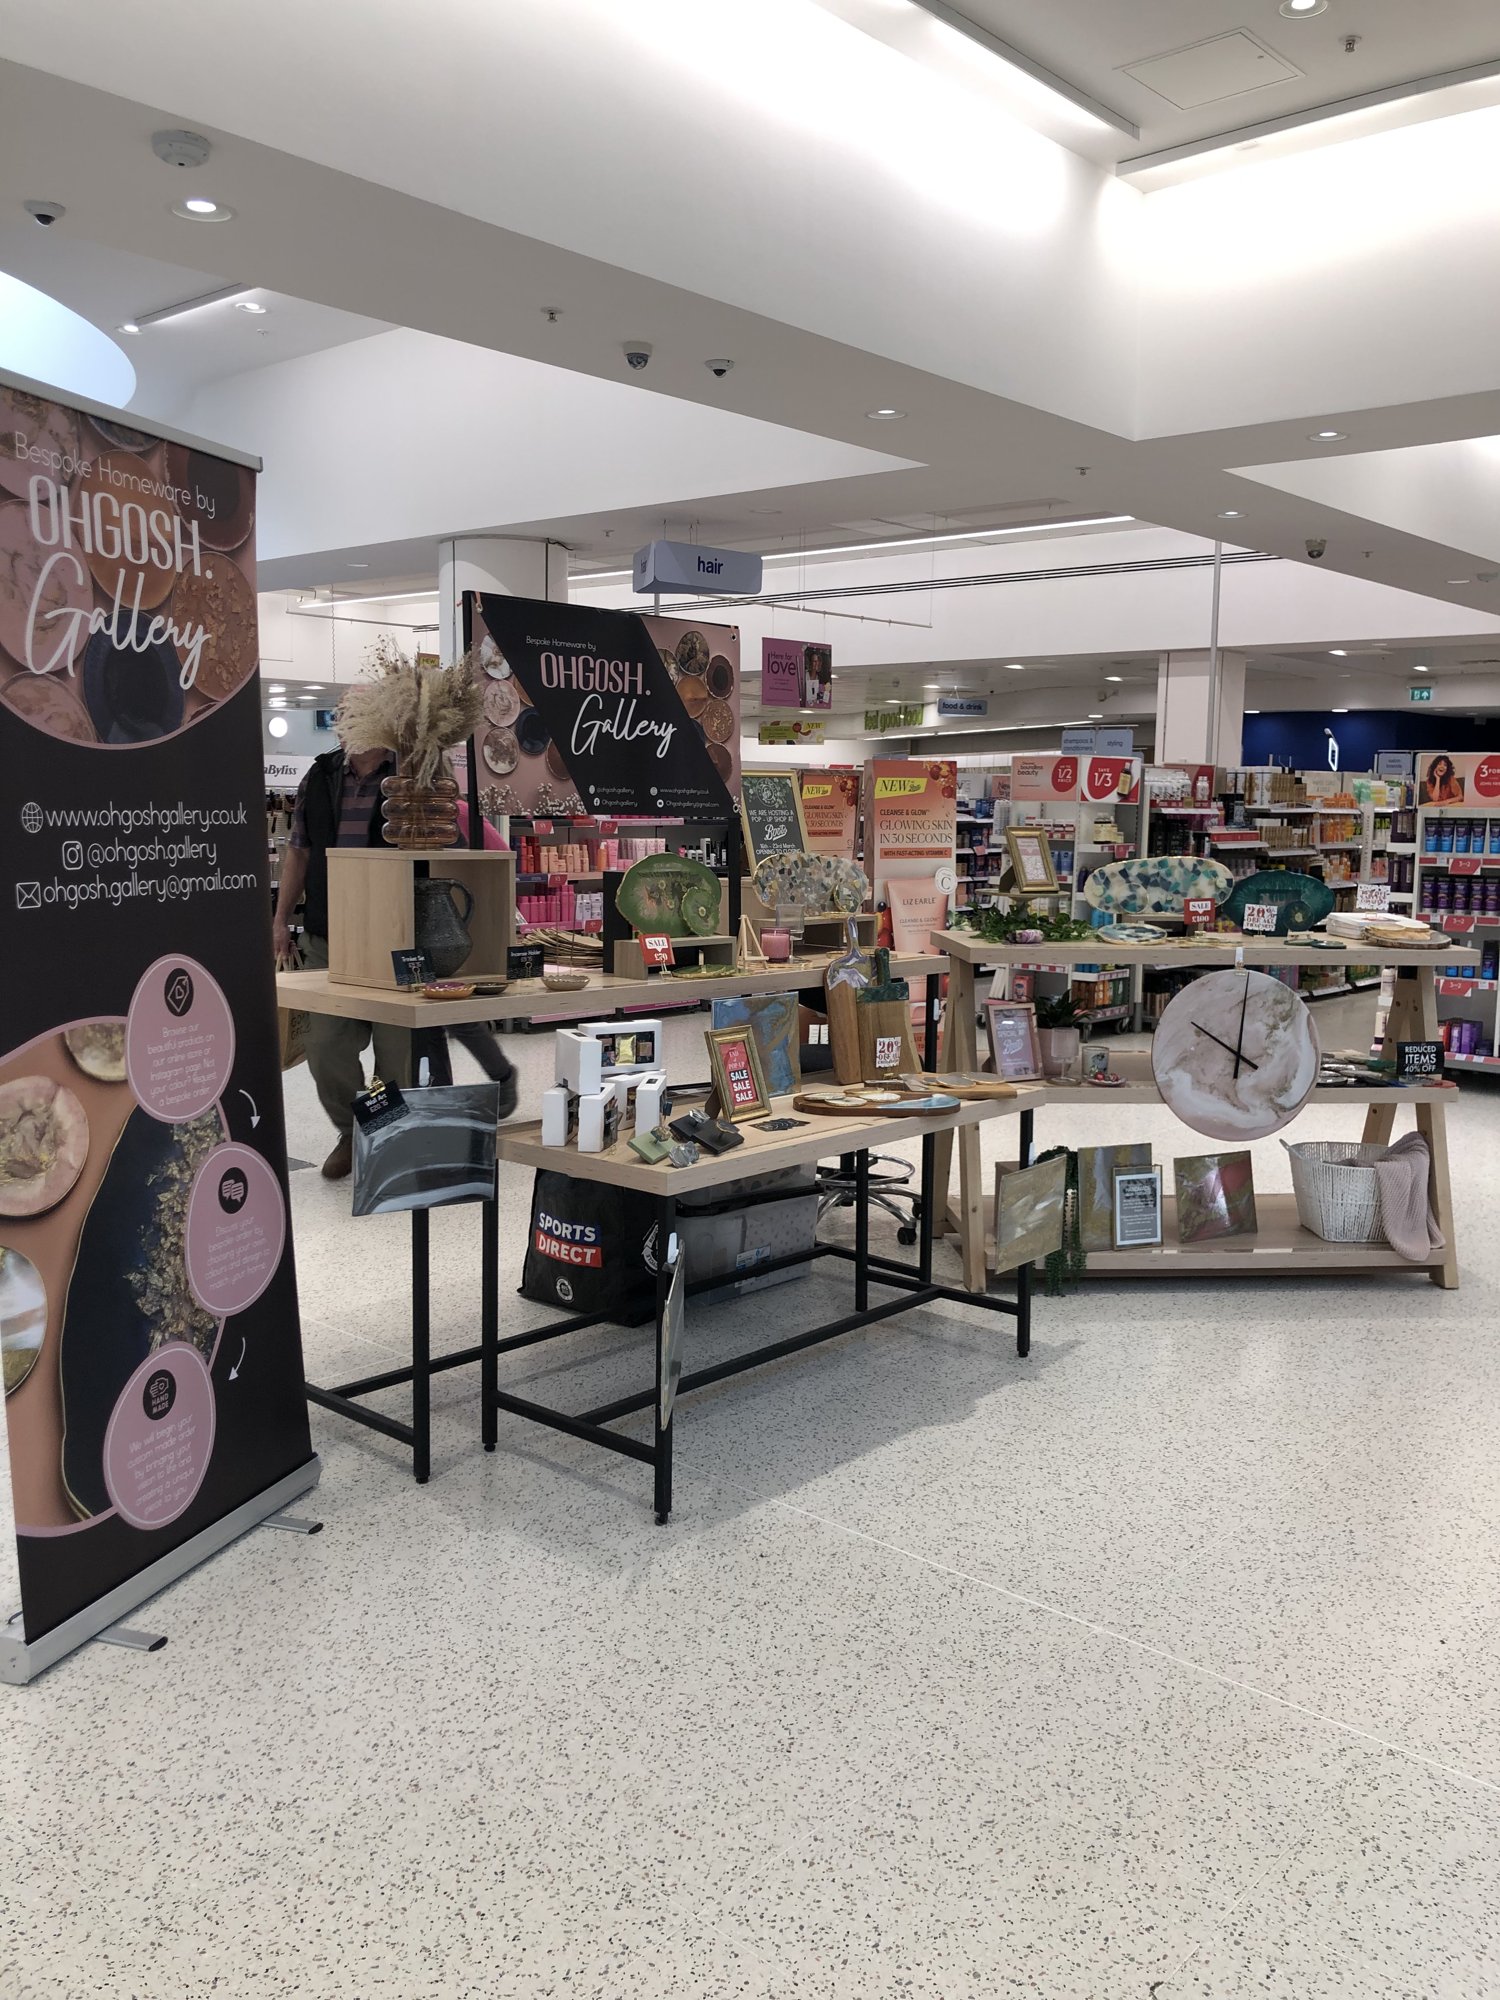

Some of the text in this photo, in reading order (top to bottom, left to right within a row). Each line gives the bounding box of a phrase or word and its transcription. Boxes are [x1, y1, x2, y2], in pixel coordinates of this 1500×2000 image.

[15, 431, 216, 519] Bespoke Homeware by
[29, 475, 213, 580] OHGOSH.
[698, 556, 724, 574] hair
[25, 551, 212, 691] Gallery
[526, 636, 596, 652] Bespoke Homeware by
[771, 651, 784, 660] Here
[768, 653, 796, 676] love
[540, 652, 651, 696] OHGOSH.
[571, 694, 678, 758] Gallery
[1058, 768, 1072, 778] 1/2
[1480, 765, 1488, 777] 3
[880, 780, 909, 792] NEW
[1094, 772, 1112, 786] 1/3
[45, 800, 248, 834] www.ohgoshgallery.co.uk
[880, 820, 952, 830] GLOWING SKIN
[764, 824, 788, 841] Boots
[880, 834, 890, 844] IN
[906, 833, 952, 844] SECONDS
[87, 835, 217, 870] @ohgosh.gallery
[43, 868, 258, 910] ohgosh.gallery@gmail.com
[941, 876, 951, 890] C
[648, 940, 666, 948] SALE
[1406, 1054, 1436, 1064] ITEMS
[730, 1070, 748, 1081] SALE
[733, 1080, 750, 1092] SALE
[736, 1090, 754, 1102] SALE
[539, 1212, 596, 1242] SPORTS
[539, 1234, 596, 1264] DIRECT
[152, 1393, 168, 1406] HAND
[152, 1402, 168, 1414] MADE
